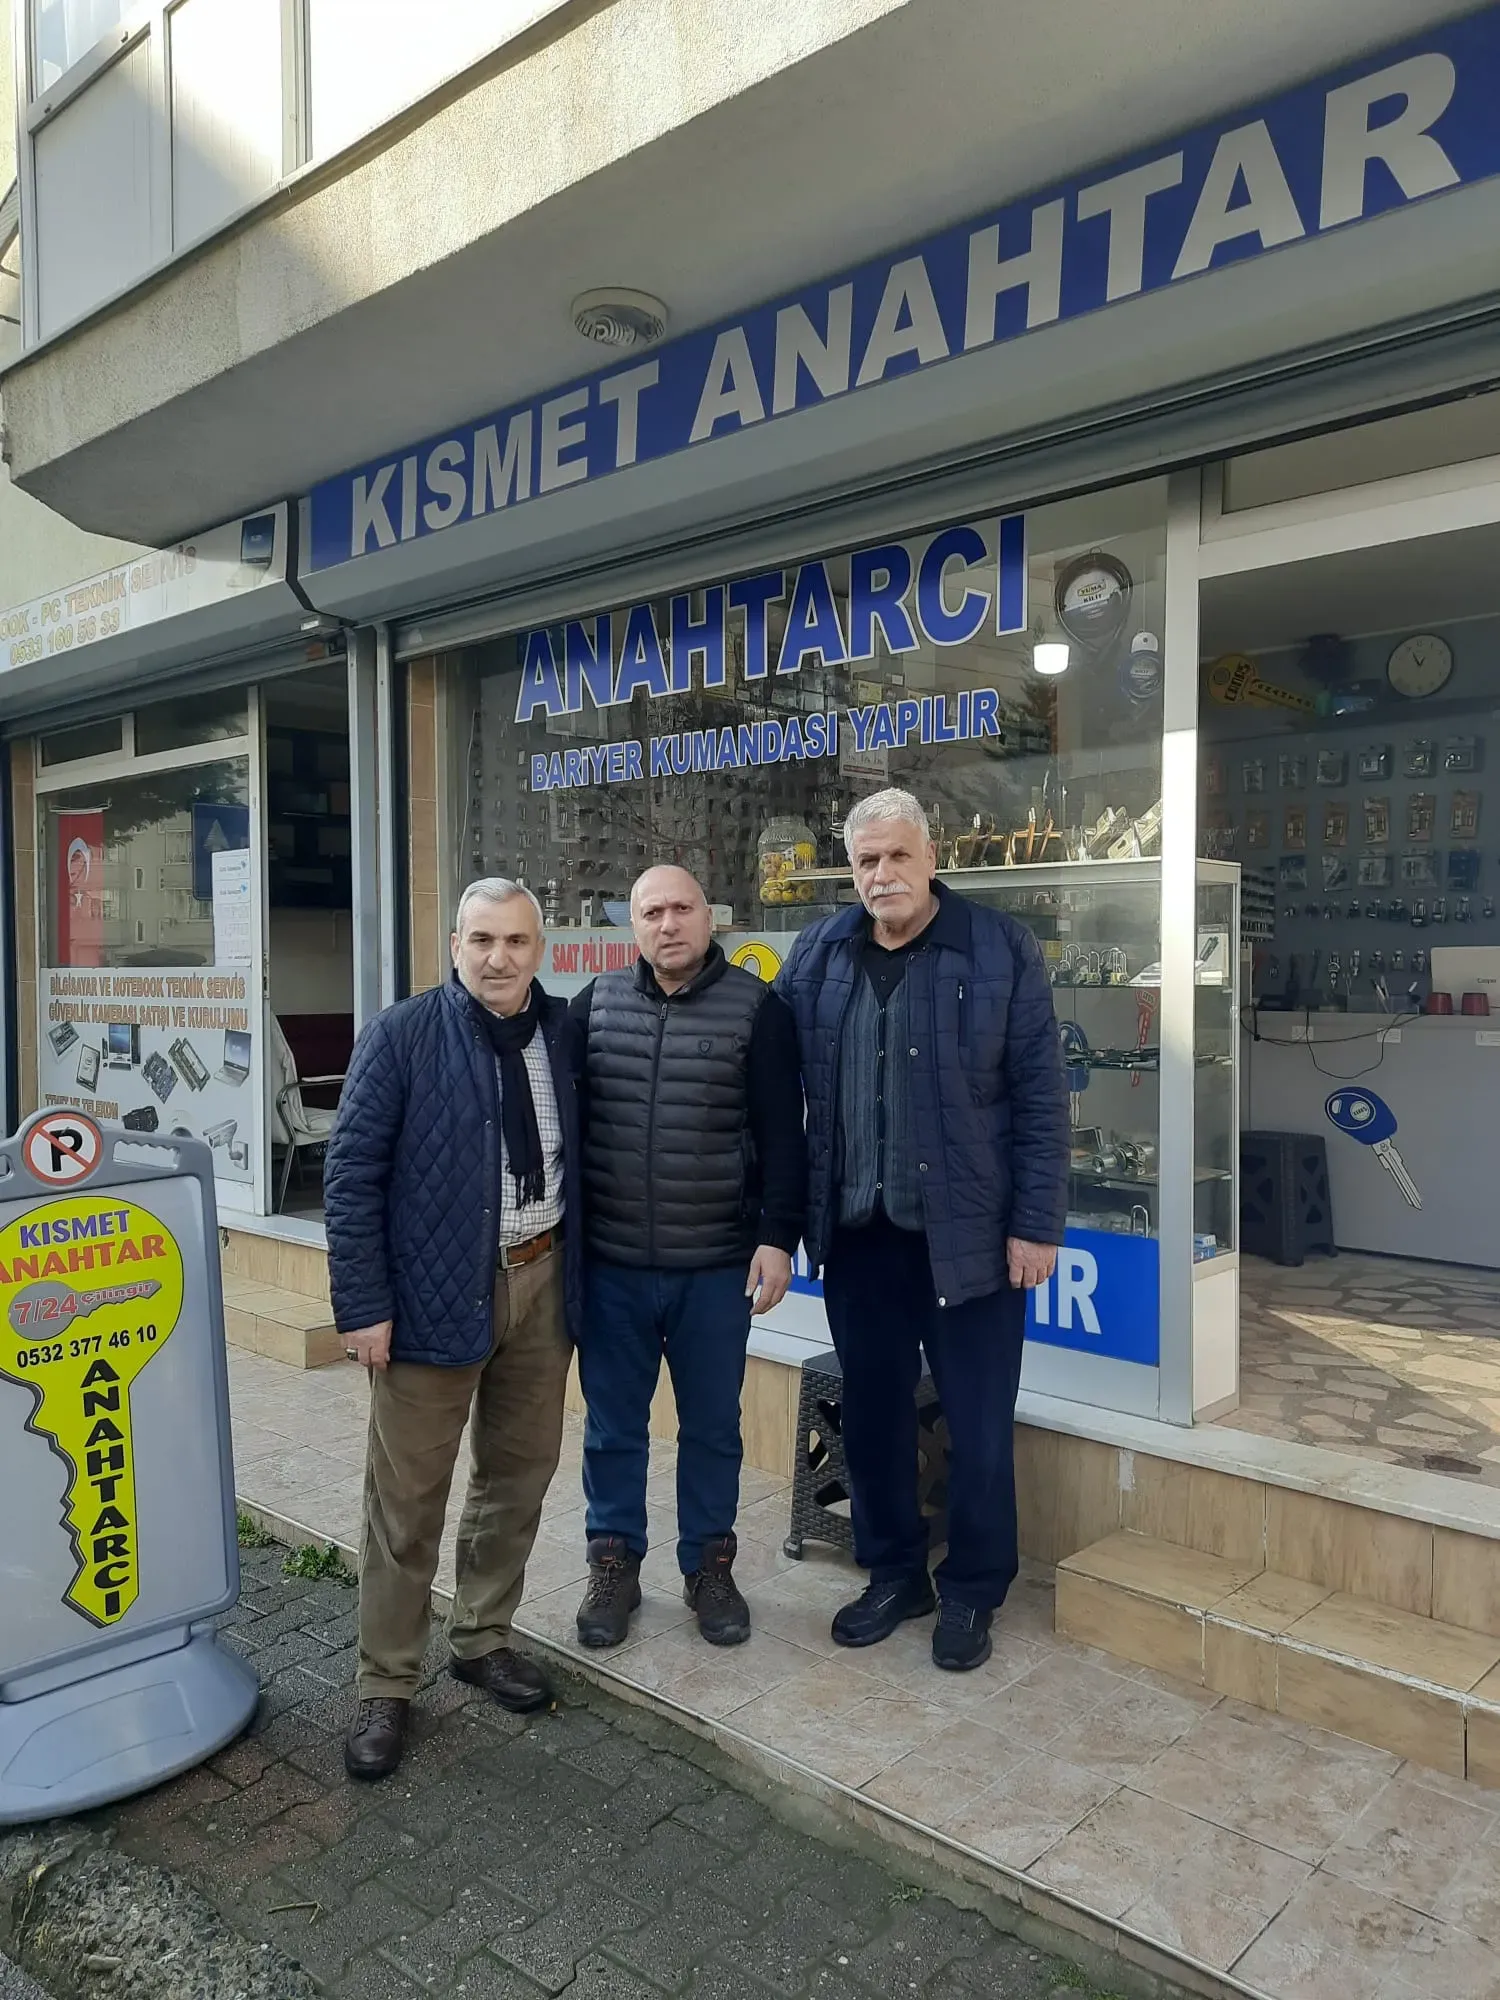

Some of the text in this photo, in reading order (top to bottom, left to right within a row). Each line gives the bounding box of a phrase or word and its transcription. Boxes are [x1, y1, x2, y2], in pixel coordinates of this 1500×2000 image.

[349, 52, 1462, 556] KISMET ANAHTAR
[41, 598, 61, 626] PC
[64, 572, 128, 618] TEKNİK
[514, 513, 1028, 724] ANAHTARCI
[650, 711, 838, 778] KUMANDASI
[847, 688, 1002, 753] YAPILIR
[552, 943, 580, 973] SAAT
[99, 976, 112, 997] VE
[113, 977, 164, 998] NOTEBOOK
[166, 972, 204, 999] TEKNİK
[207, 972, 246, 1000] SERVİS
[172, 1006, 186, 1028] VE
[188, 1007, 249, 1031] KURULUMU
[20, 1209, 130, 1248] KISMET
[13, 1293, 79, 1326] 7/24
[17, 1324, 157, 1369] 0532 377 46 10
[80, 1358, 130, 1617] ANAHTARCI
